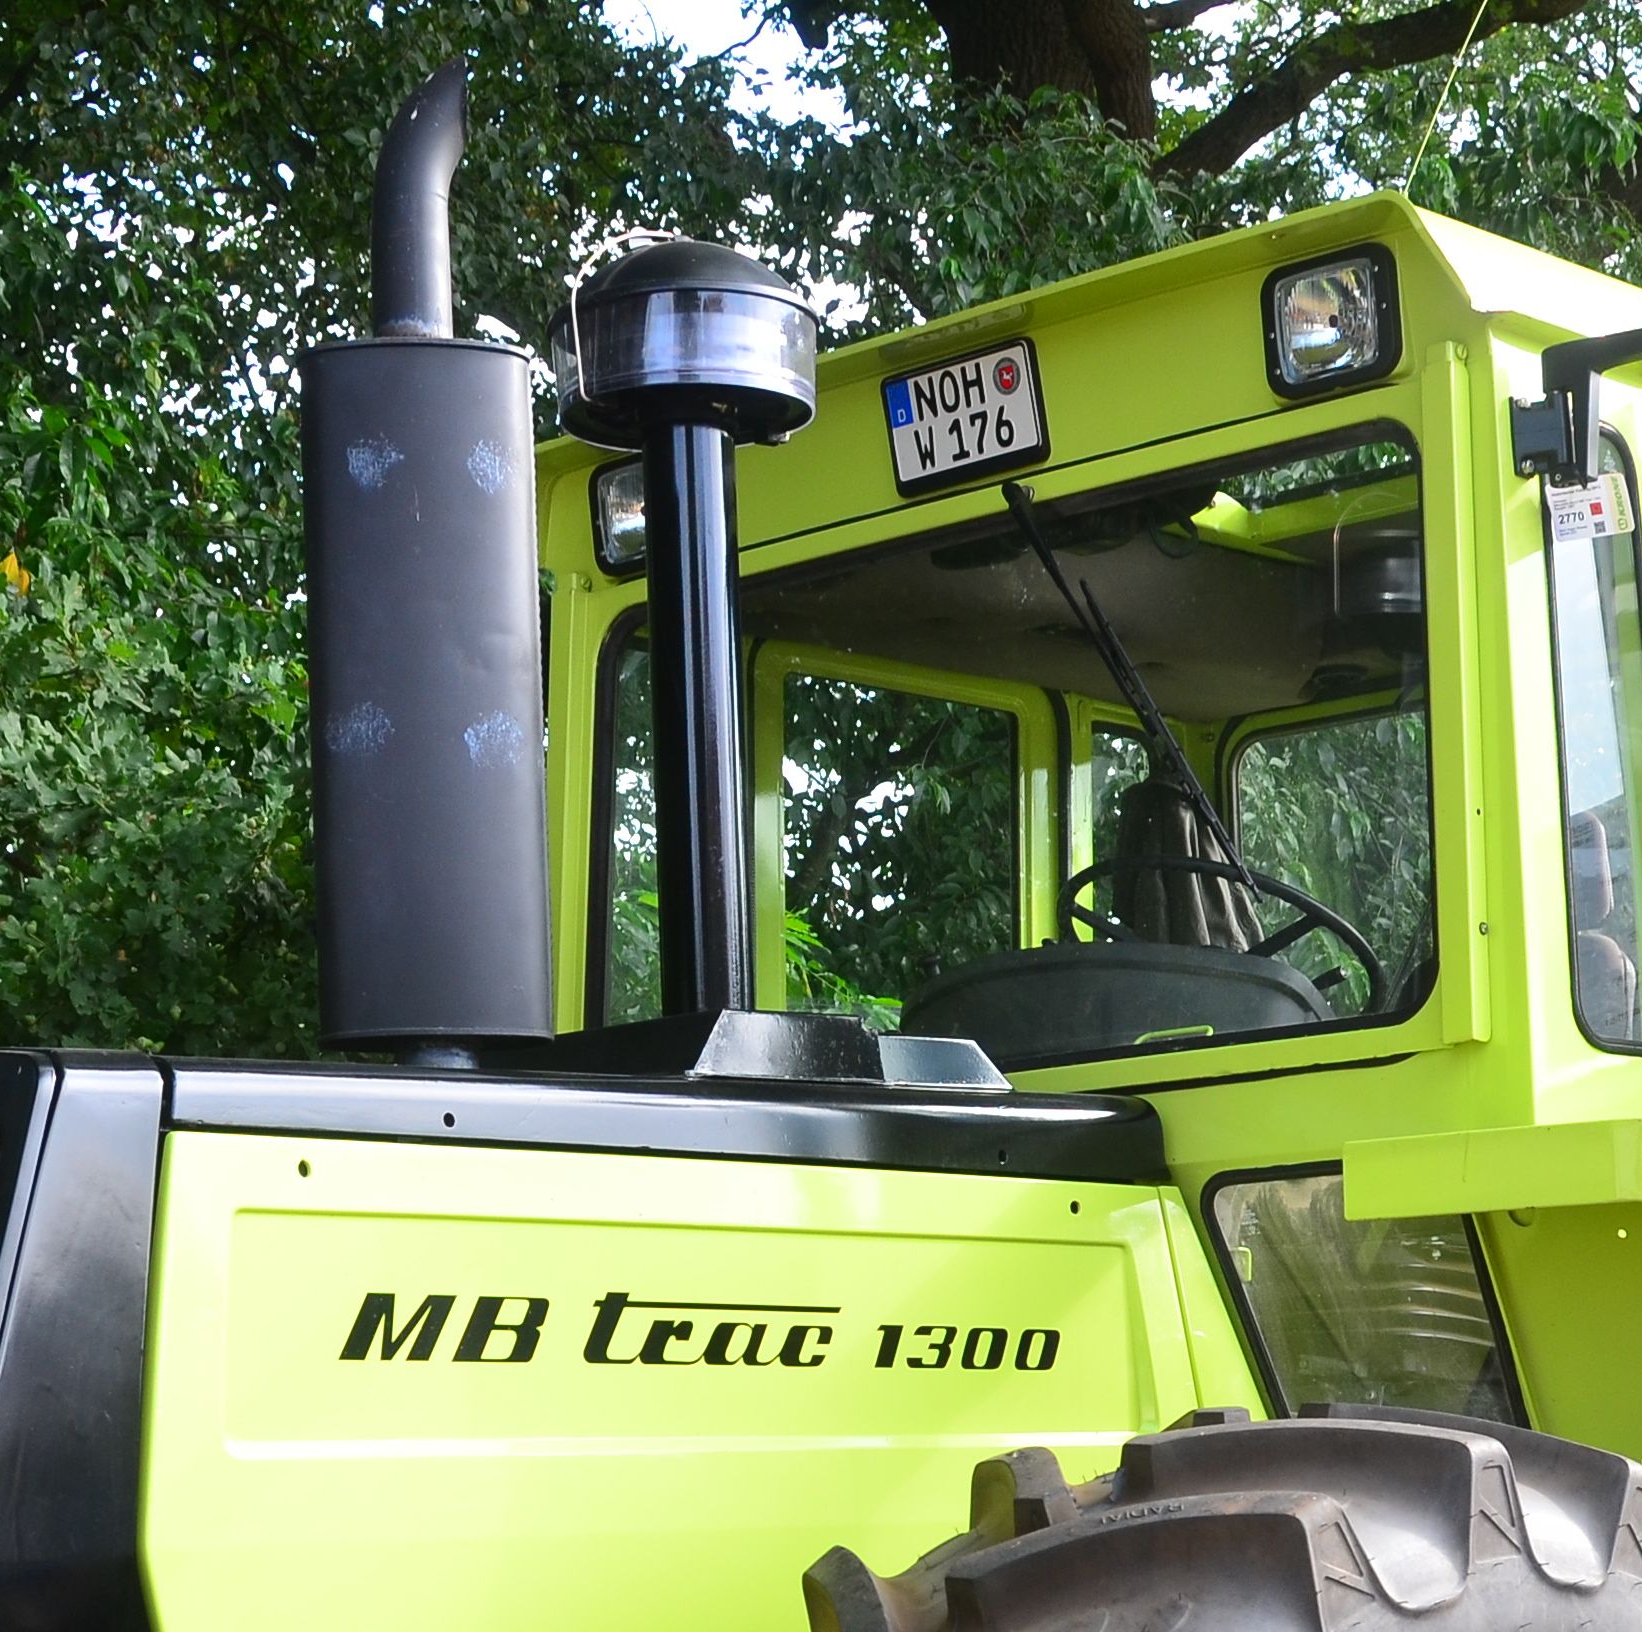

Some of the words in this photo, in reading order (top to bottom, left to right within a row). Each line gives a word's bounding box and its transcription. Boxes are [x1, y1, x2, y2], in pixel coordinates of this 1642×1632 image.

[898, 408, 907, 423] D
[912, 361, 987, 422] NOH
[913, 425, 936, 471] W
[947, 405, 1015, 462] 176
[1558, 511, 1585, 525] 2770
[338, 1292, 550, 1364] MB
[582, 1291, 843, 1368] trac
[873, 1323, 1061, 1372] 1300
